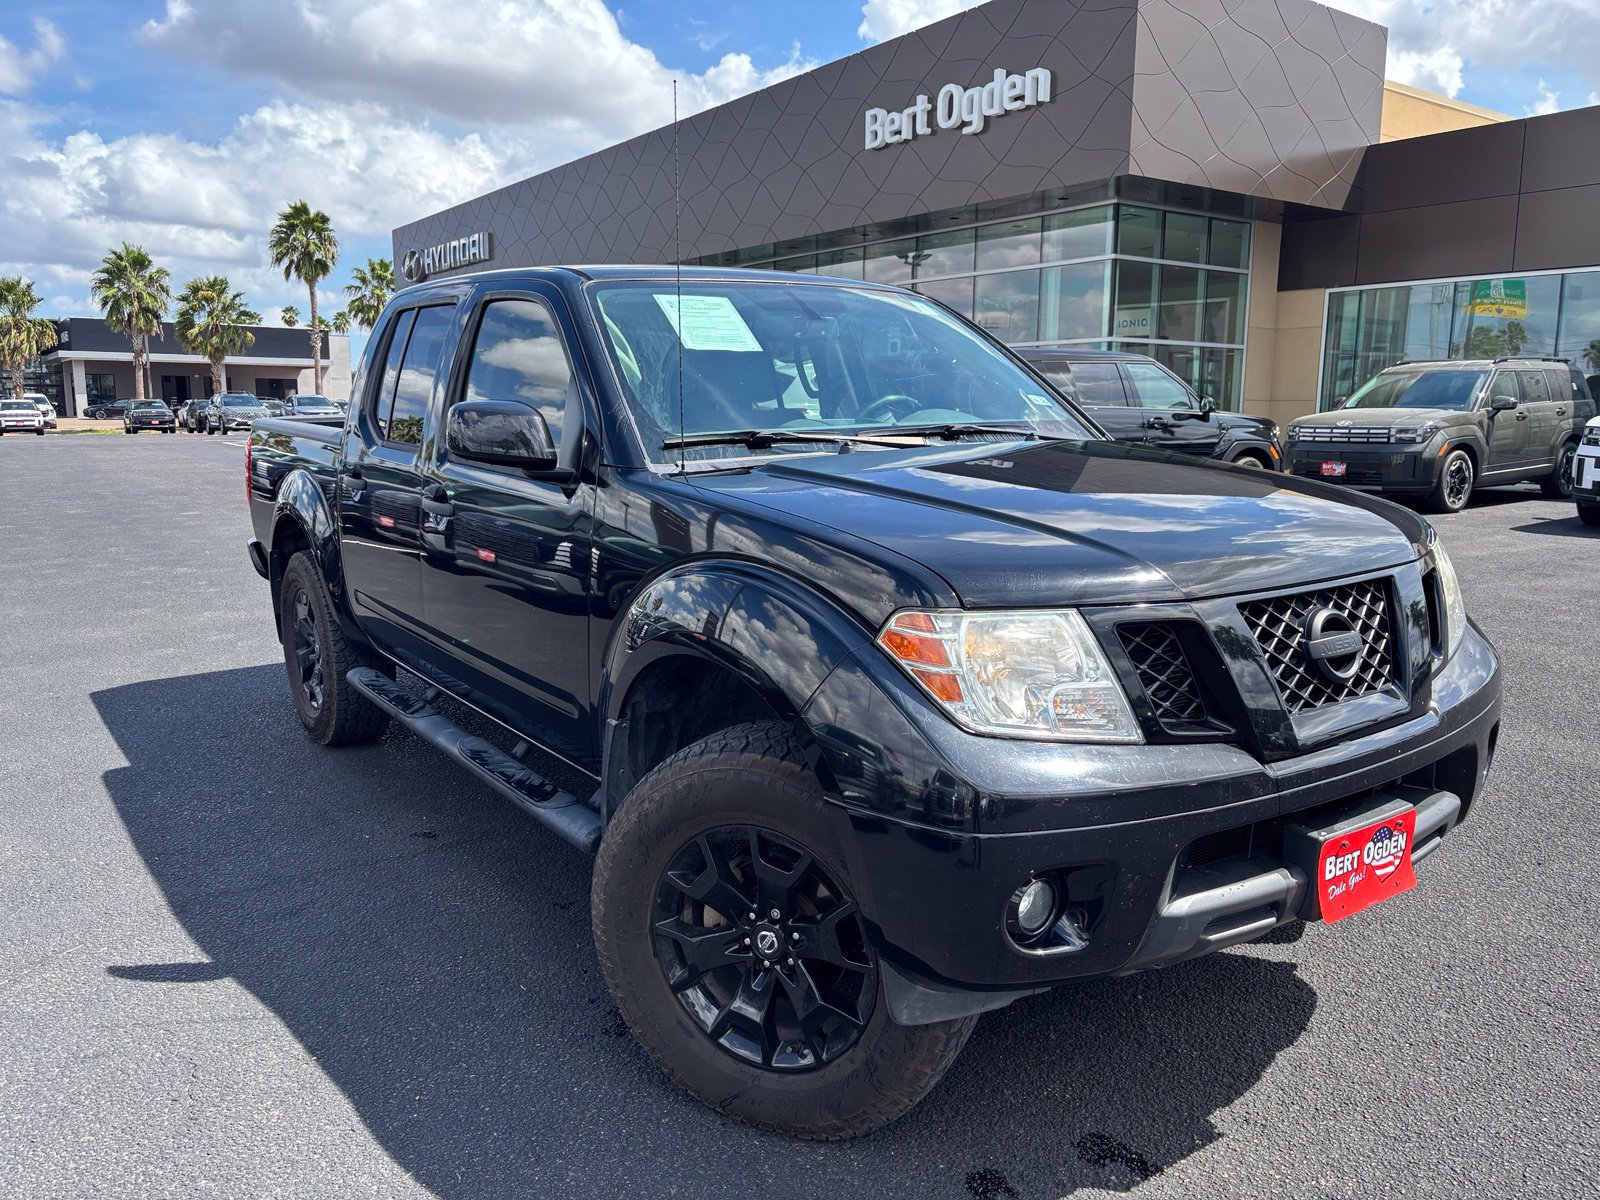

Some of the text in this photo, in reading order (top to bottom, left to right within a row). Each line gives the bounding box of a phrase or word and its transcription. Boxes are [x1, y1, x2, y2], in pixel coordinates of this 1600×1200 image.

[865, 67, 1051, 150] Bert Ogden
[424, 232, 489, 274] HYUNDAI
[1325, 832, 1407, 880] BERT OGDEN
[1328, 881, 1347, 900] Dale
